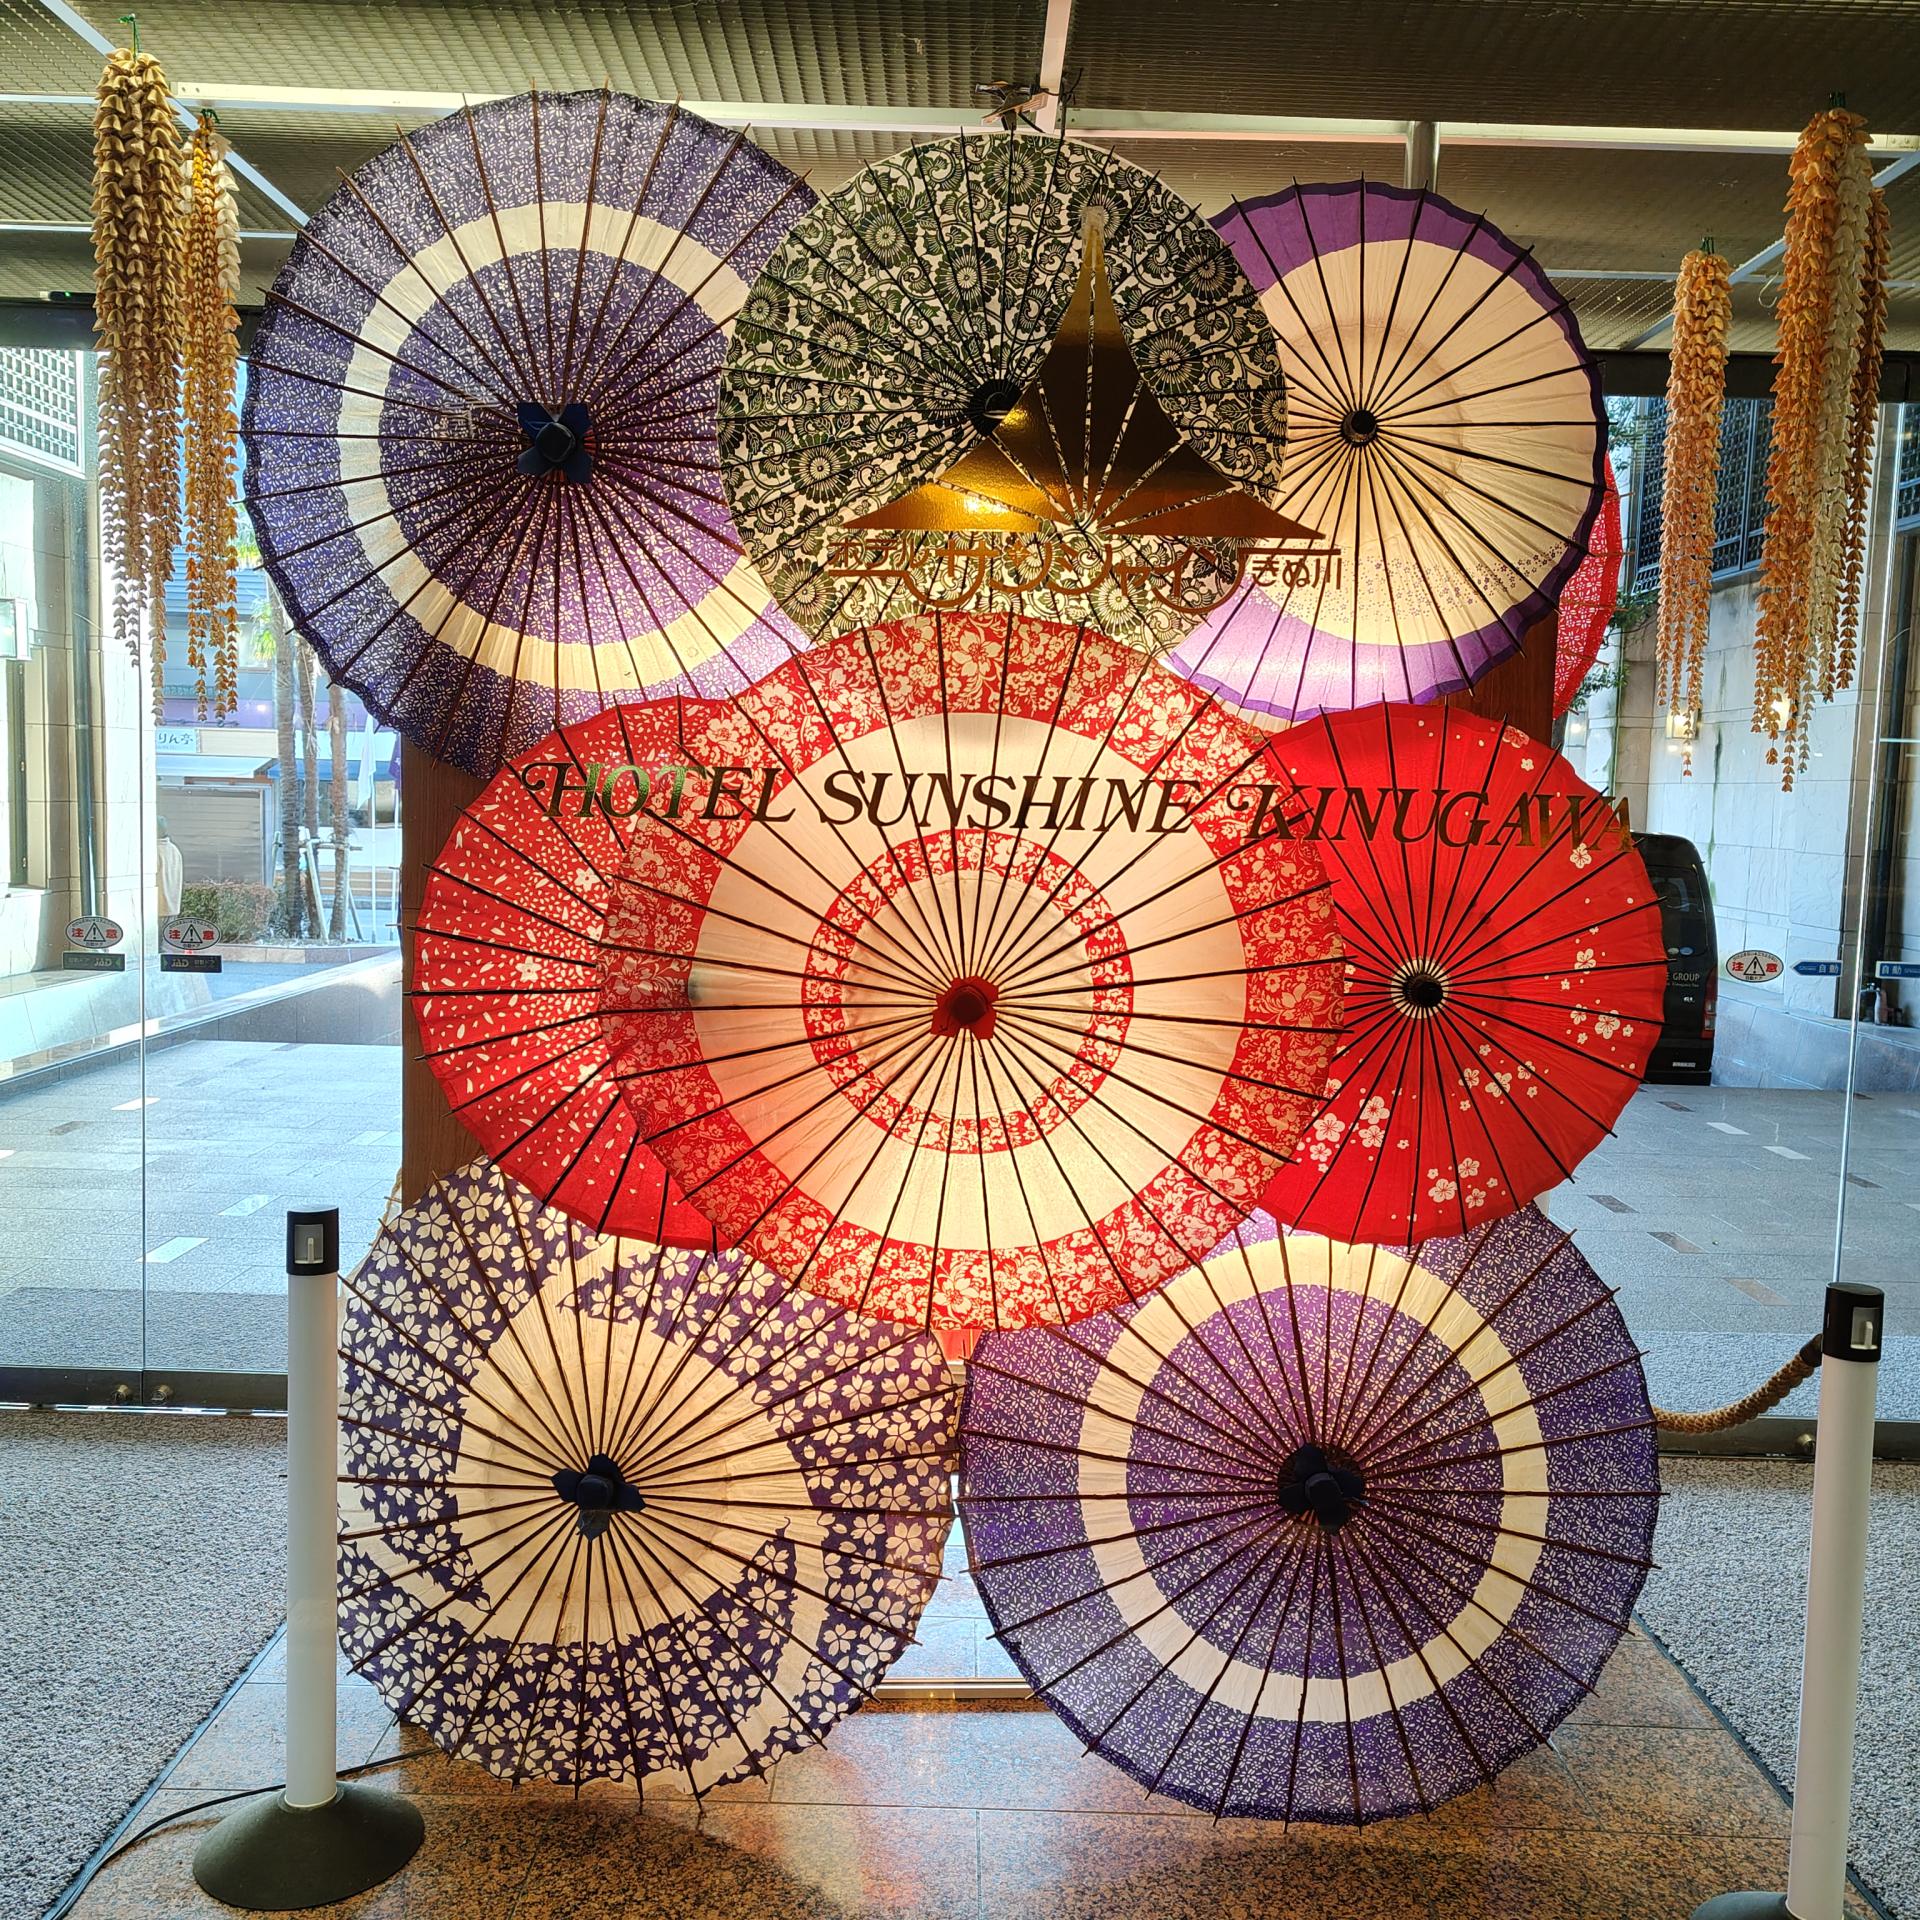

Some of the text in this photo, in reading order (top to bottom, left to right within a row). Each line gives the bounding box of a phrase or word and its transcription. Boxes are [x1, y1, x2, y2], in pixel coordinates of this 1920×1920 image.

[827, 538, 1342, 614] ホテル サンシャイン きぬ川
[520, 762, 1637, 853] HOTEL SUNSHINE KINUGAWA
[1672, 972, 1700, 982] GROUP
